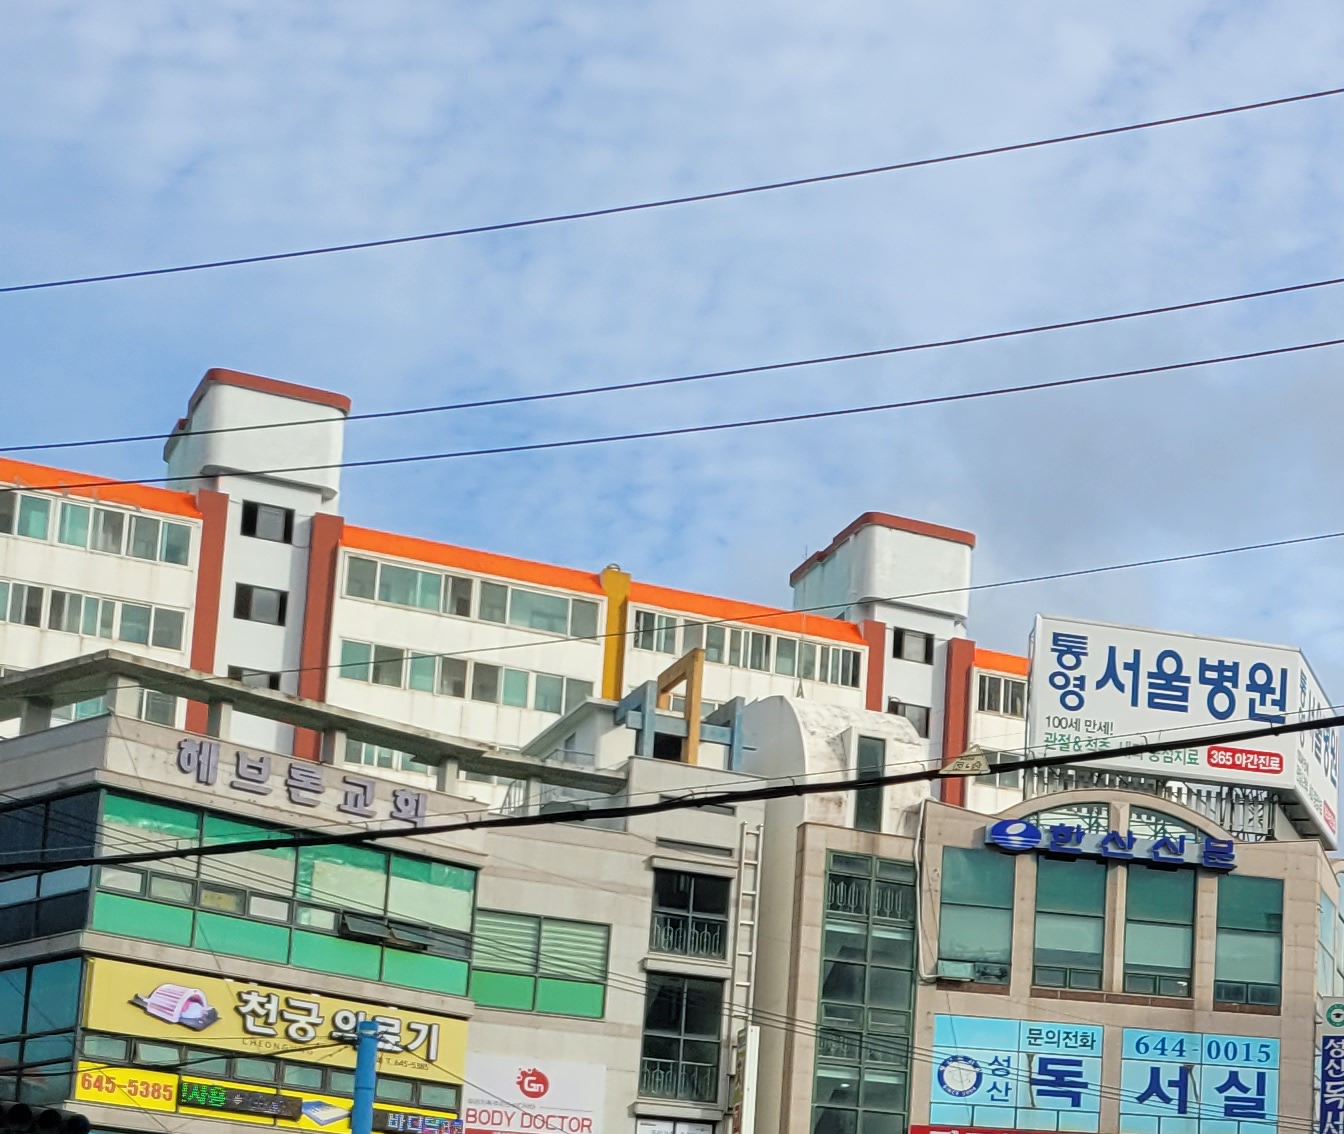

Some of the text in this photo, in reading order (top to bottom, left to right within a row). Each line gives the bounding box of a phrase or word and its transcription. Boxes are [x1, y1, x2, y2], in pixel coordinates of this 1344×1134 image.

[1096, 646, 1288, 724] 서울병원
[1046, 716, 1080, 732] 100세
[1211, 750, 1233, 765] 365
[177, 737, 429, 828] 헤브론교회
[1050, 822, 1236, 871] 한산신문
[236, 990, 324, 1042] 천궁
[1027, 1028, 1096, 1050] 문의전화
[81, 1073, 173, 1101] 645-5385
[465, 1107, 515, 1128] BODY
[521, 1112, 592, 1134] DOCTOR
